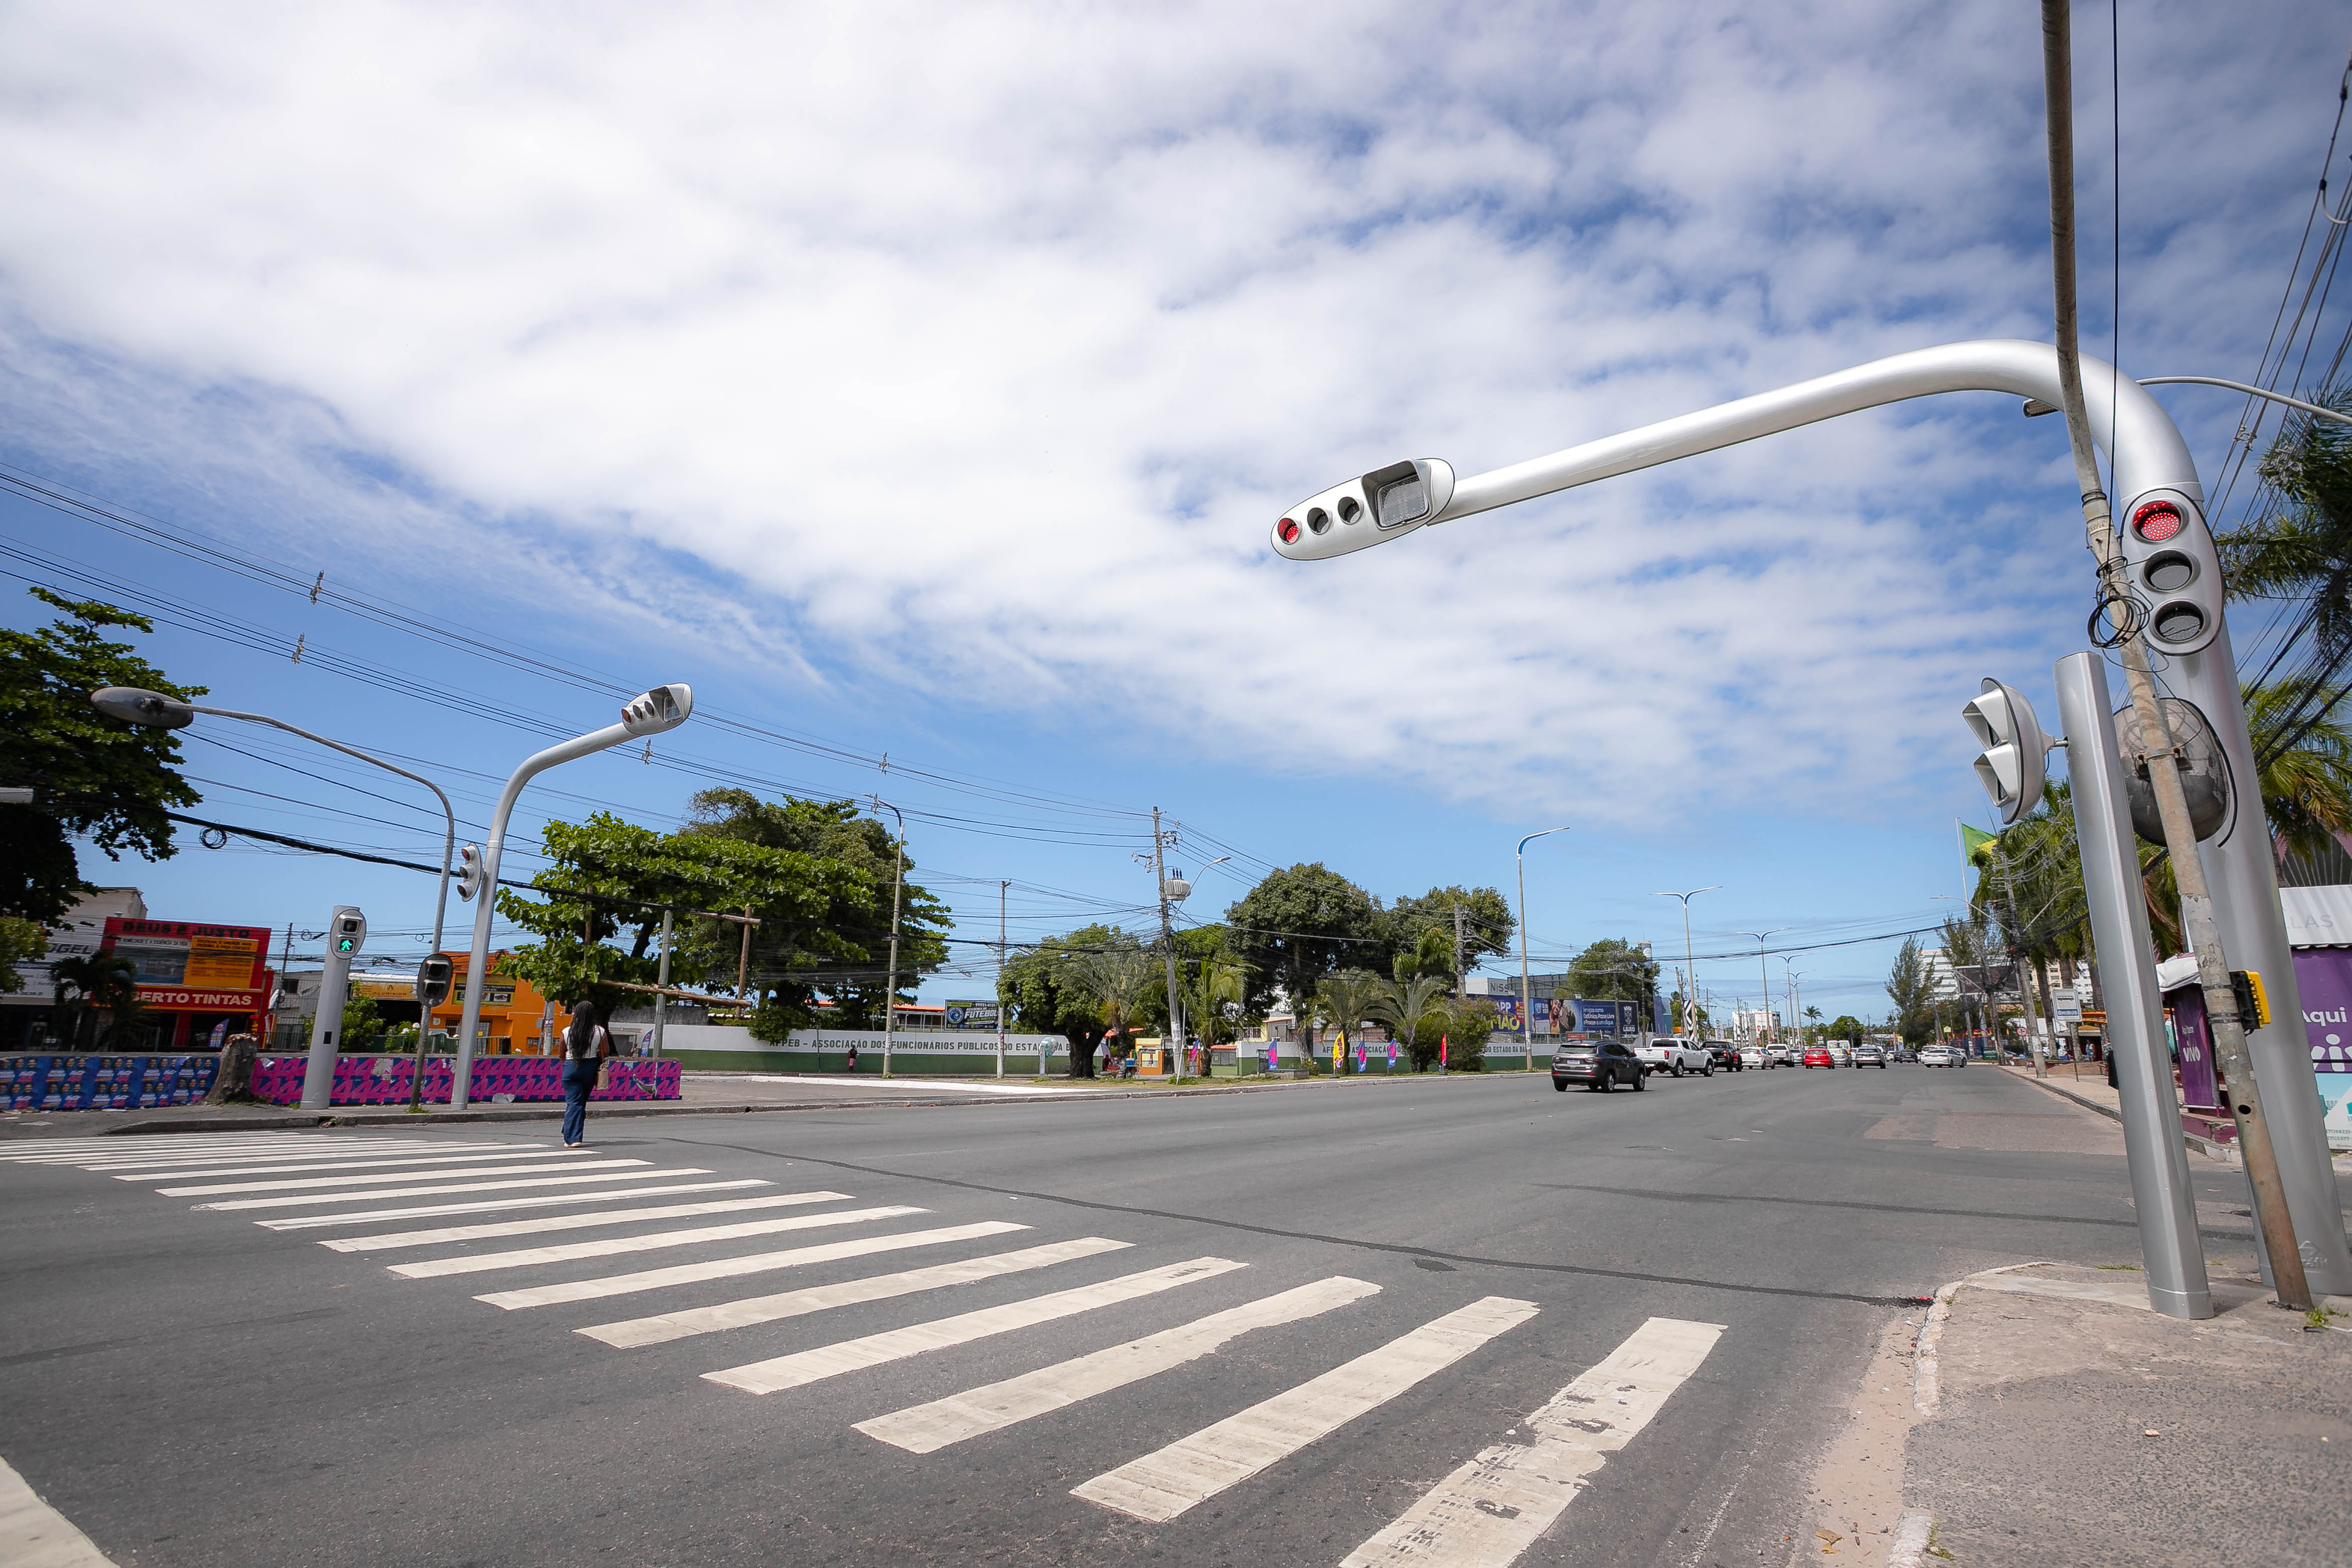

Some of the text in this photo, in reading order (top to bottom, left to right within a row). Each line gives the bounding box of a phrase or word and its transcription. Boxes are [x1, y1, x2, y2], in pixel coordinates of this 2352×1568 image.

[123, 921, 171, 934] DEUS
[192, 926, 250, 938] JUSTO
[1490, 983, 1508, 993] NISS
[192, 994, 252, 1005] TINTAS
[964, 1009, 997, 1019] FUTEBOL
[891, 1040, 954, 1050] FUNCIONÁRIOS
[957, 1040, 998, 1050] PÚBLICOS
